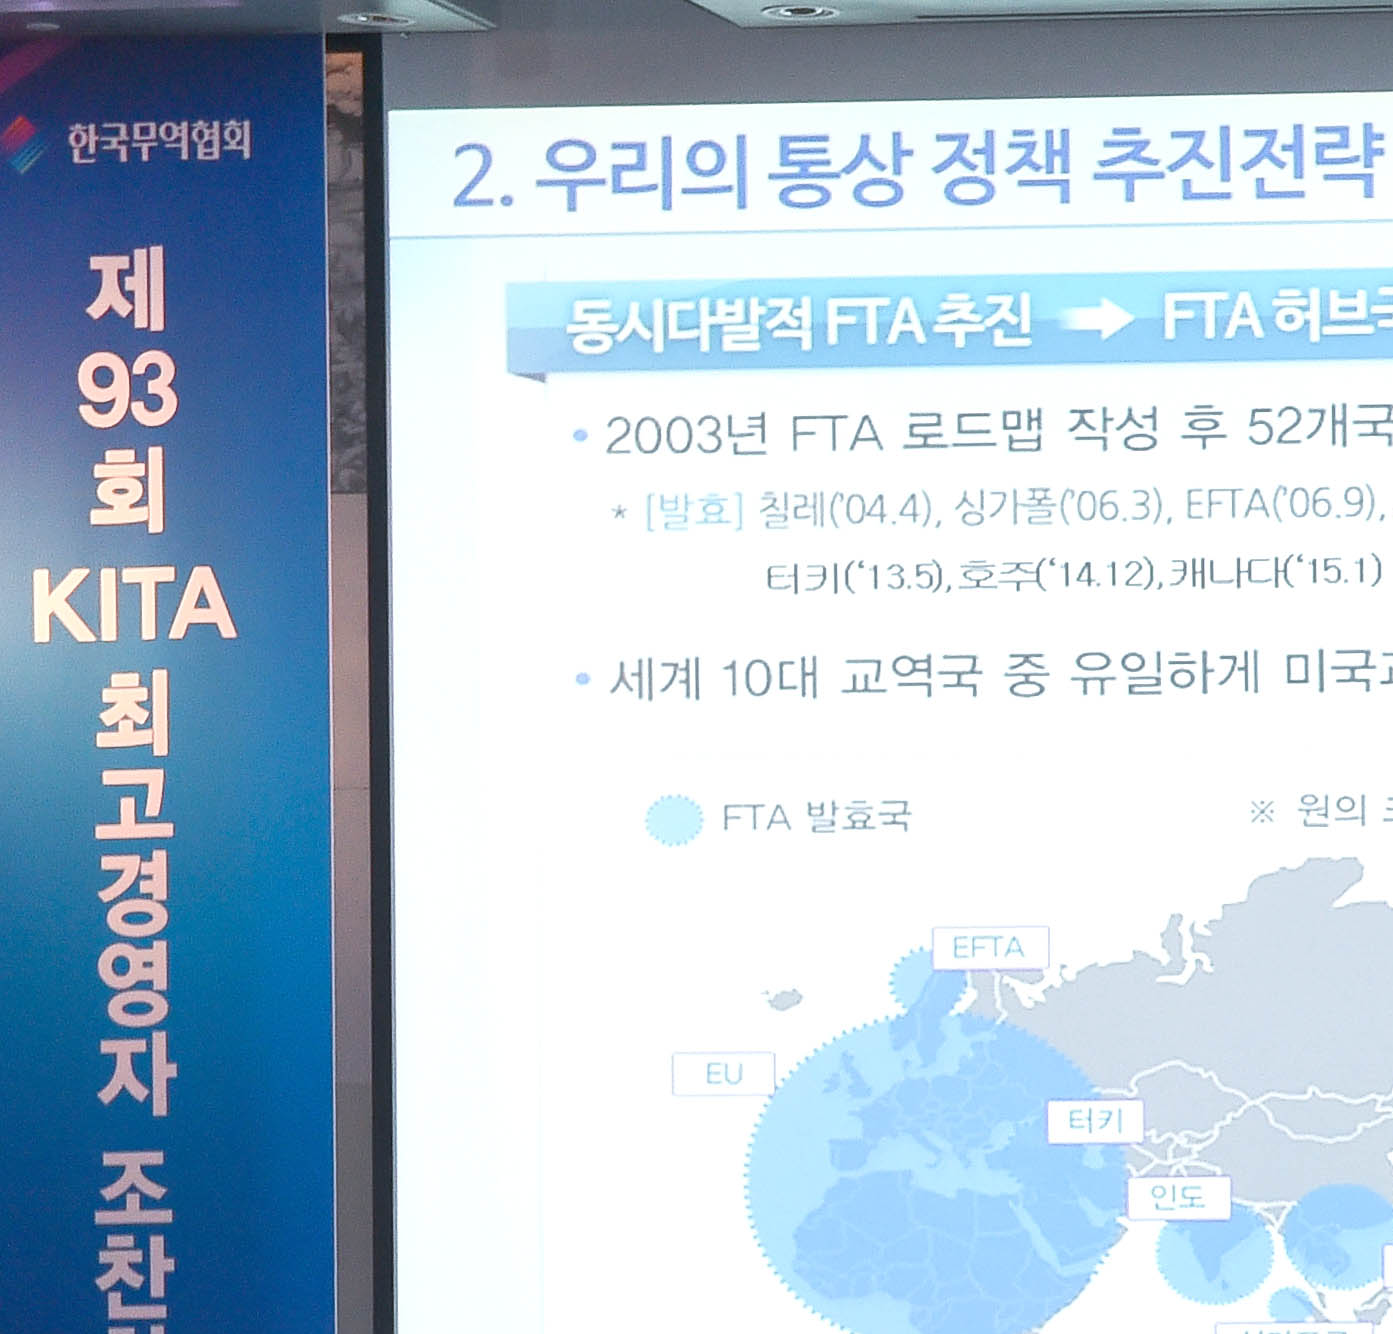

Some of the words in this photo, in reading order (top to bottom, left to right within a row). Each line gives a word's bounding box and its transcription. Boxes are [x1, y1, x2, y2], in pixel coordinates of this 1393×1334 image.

[68, 120, 250, 163] 한국무역협회
[453, 143, 513, 207] 2.
[536, 134, 747, 212] 우리의
[768, 131, 914, 209] 통상
[931, 128, 1070, 206] 정책
[1093, 122, 1385, 202] 추진전략
[562, 291, 811, 354] 동시다발적
[827, 295, 933, 345] FTA
[933, 291, 1032, 347] 추진
[1165, 292, 1264, 339] FTA
[606, 412, 766, 455] 2003년
[793, 415, 883, 451] FTA
[903, 408, 1042, 452] 로드맵
[1069, 406, 1157, 451] 작성
[1181, 405, 1227, 450] 후
[647, 492, 742, 532] [발효]
[32, 565, 237, 643] KITA
[610, 657, 700, 701] 세계
[723, 656, 817, 699] 10대
[841, 654, 983, 697] 교역국
[1004, 654, 1050, 697] 중
[1071, 649, 1258, 695] 유일하게
[724, 804, 791, 830] FTA
[808, 800, 912, 833] 발효국
[1298, 794, 1365, 827] 원의
[95, 668, 177, 1118] 최고경영자
[954, 936, 1024, 959] EFTA
[707, 1062, 743, 1085] EU
[1069, 1108, 1122, 1134] 터키
[1151, 1184, 1205, 1211] 인도
